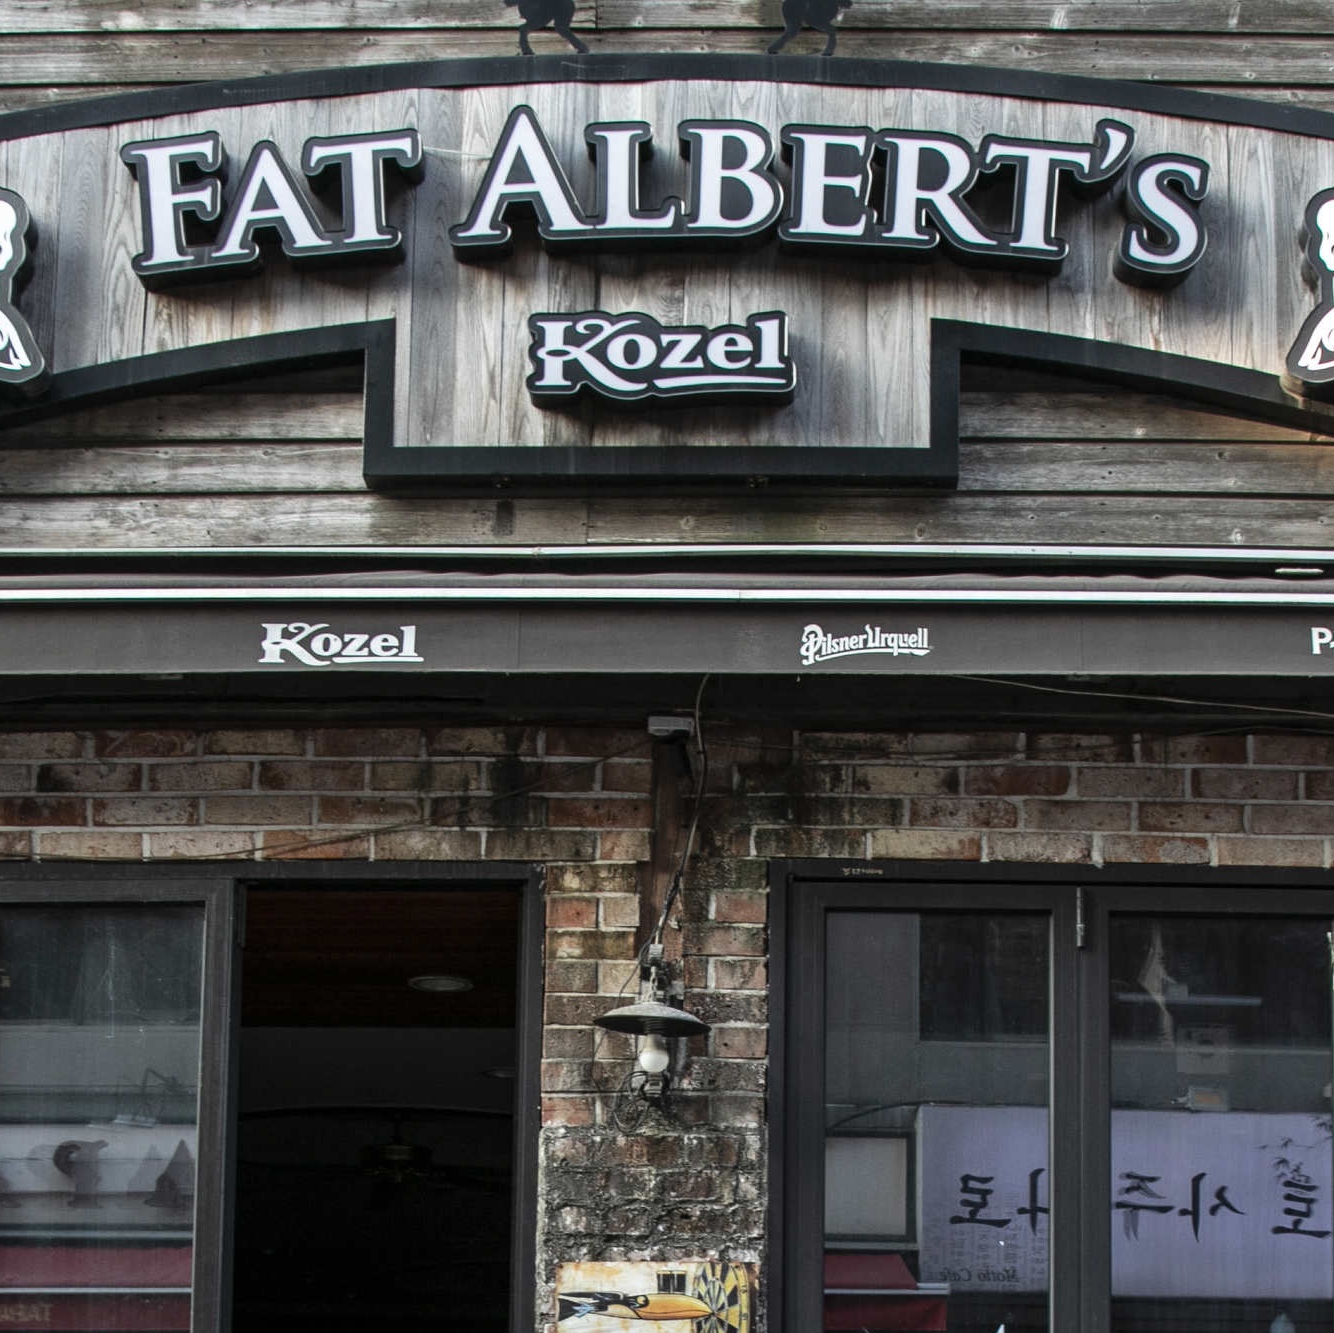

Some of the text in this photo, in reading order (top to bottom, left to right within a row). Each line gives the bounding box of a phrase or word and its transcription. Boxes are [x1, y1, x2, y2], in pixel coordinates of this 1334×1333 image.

[129, 108, 1205, 268] FAT ALBERT'S
[531, 312, 786, 388] Kozel
[258, 622, 425, 666] Kozel
[800, 624, 931, 666] Pilsner Urquell
